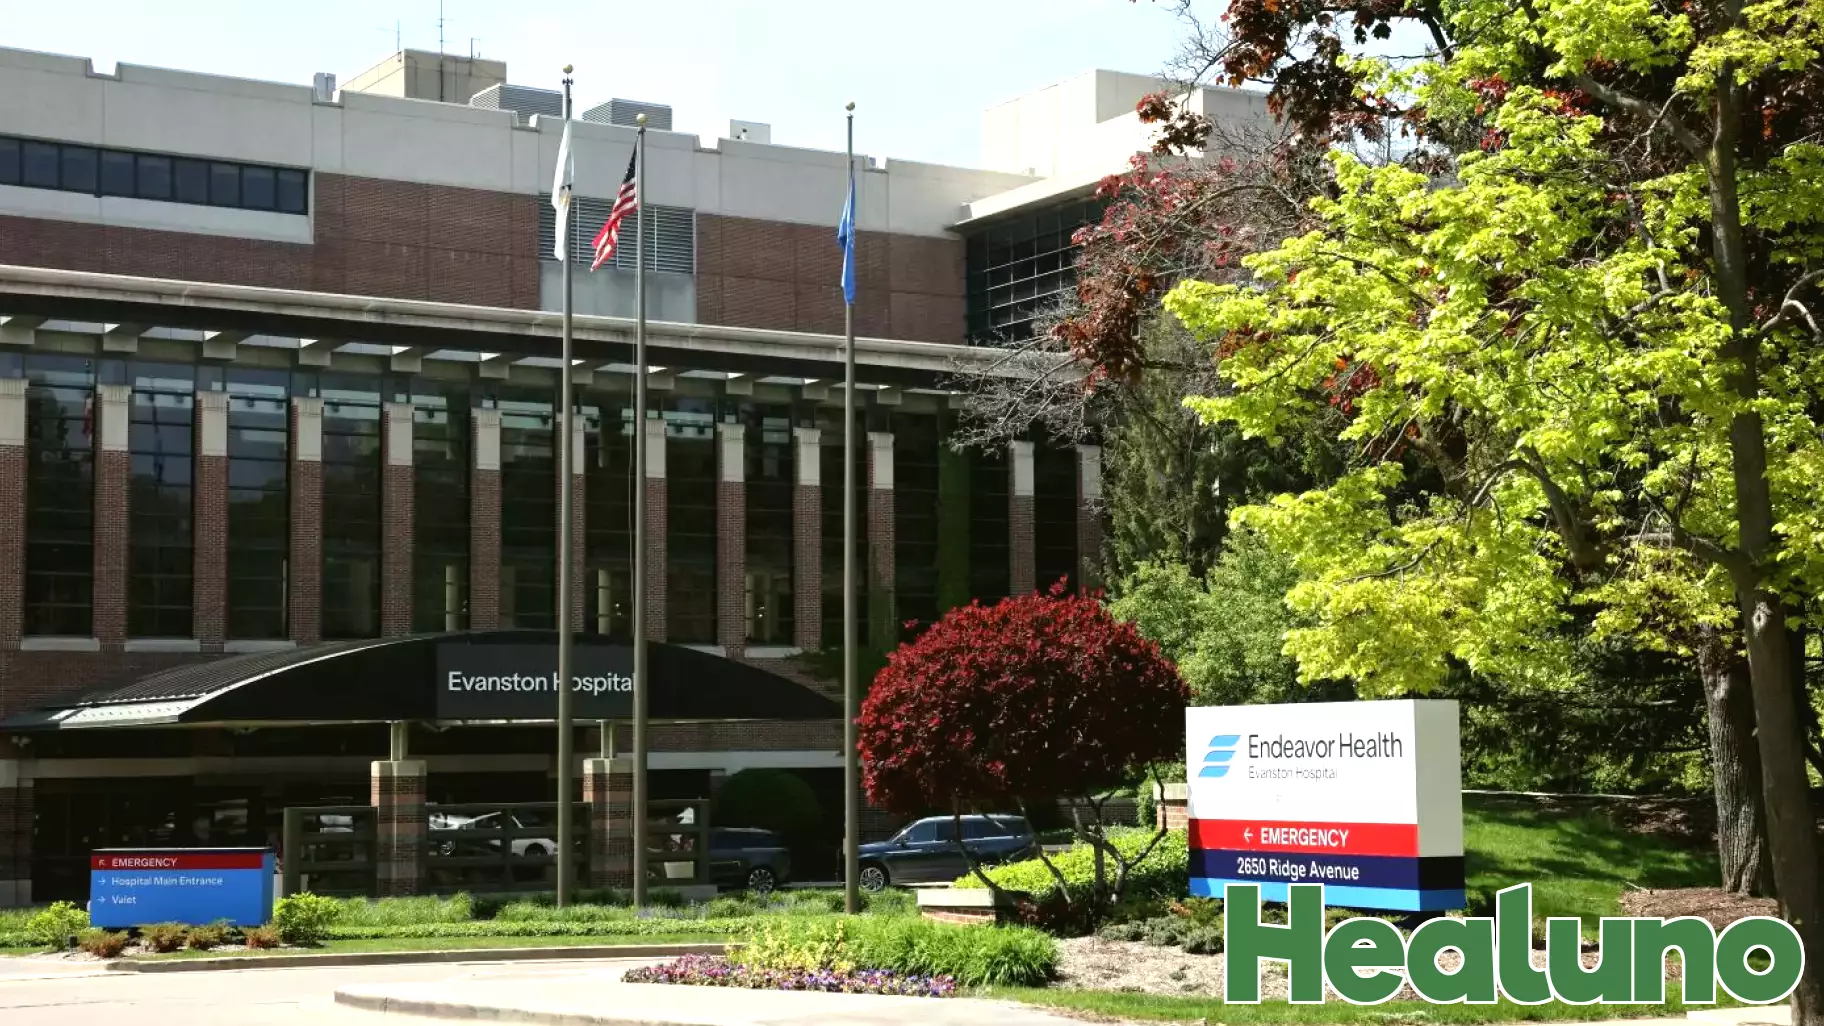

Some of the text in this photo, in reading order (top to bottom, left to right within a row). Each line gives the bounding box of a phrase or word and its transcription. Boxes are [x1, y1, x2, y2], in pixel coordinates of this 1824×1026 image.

[448, 671, 548, 691] Evanston
[1248, 731, 1403, 758] Endeavor Health
[1248, 766, 1293, 778] Evanston
[1260, 827, 1349, 847] EMERGENCY
[112, 858, 178, 867] EMERGENCY
[1237, 857, 1359, 880] 2650 Ridge Avenue
[111, 876, 223, 887] Hospital Main Entrance
[111, 895, 137, 904] Valet
